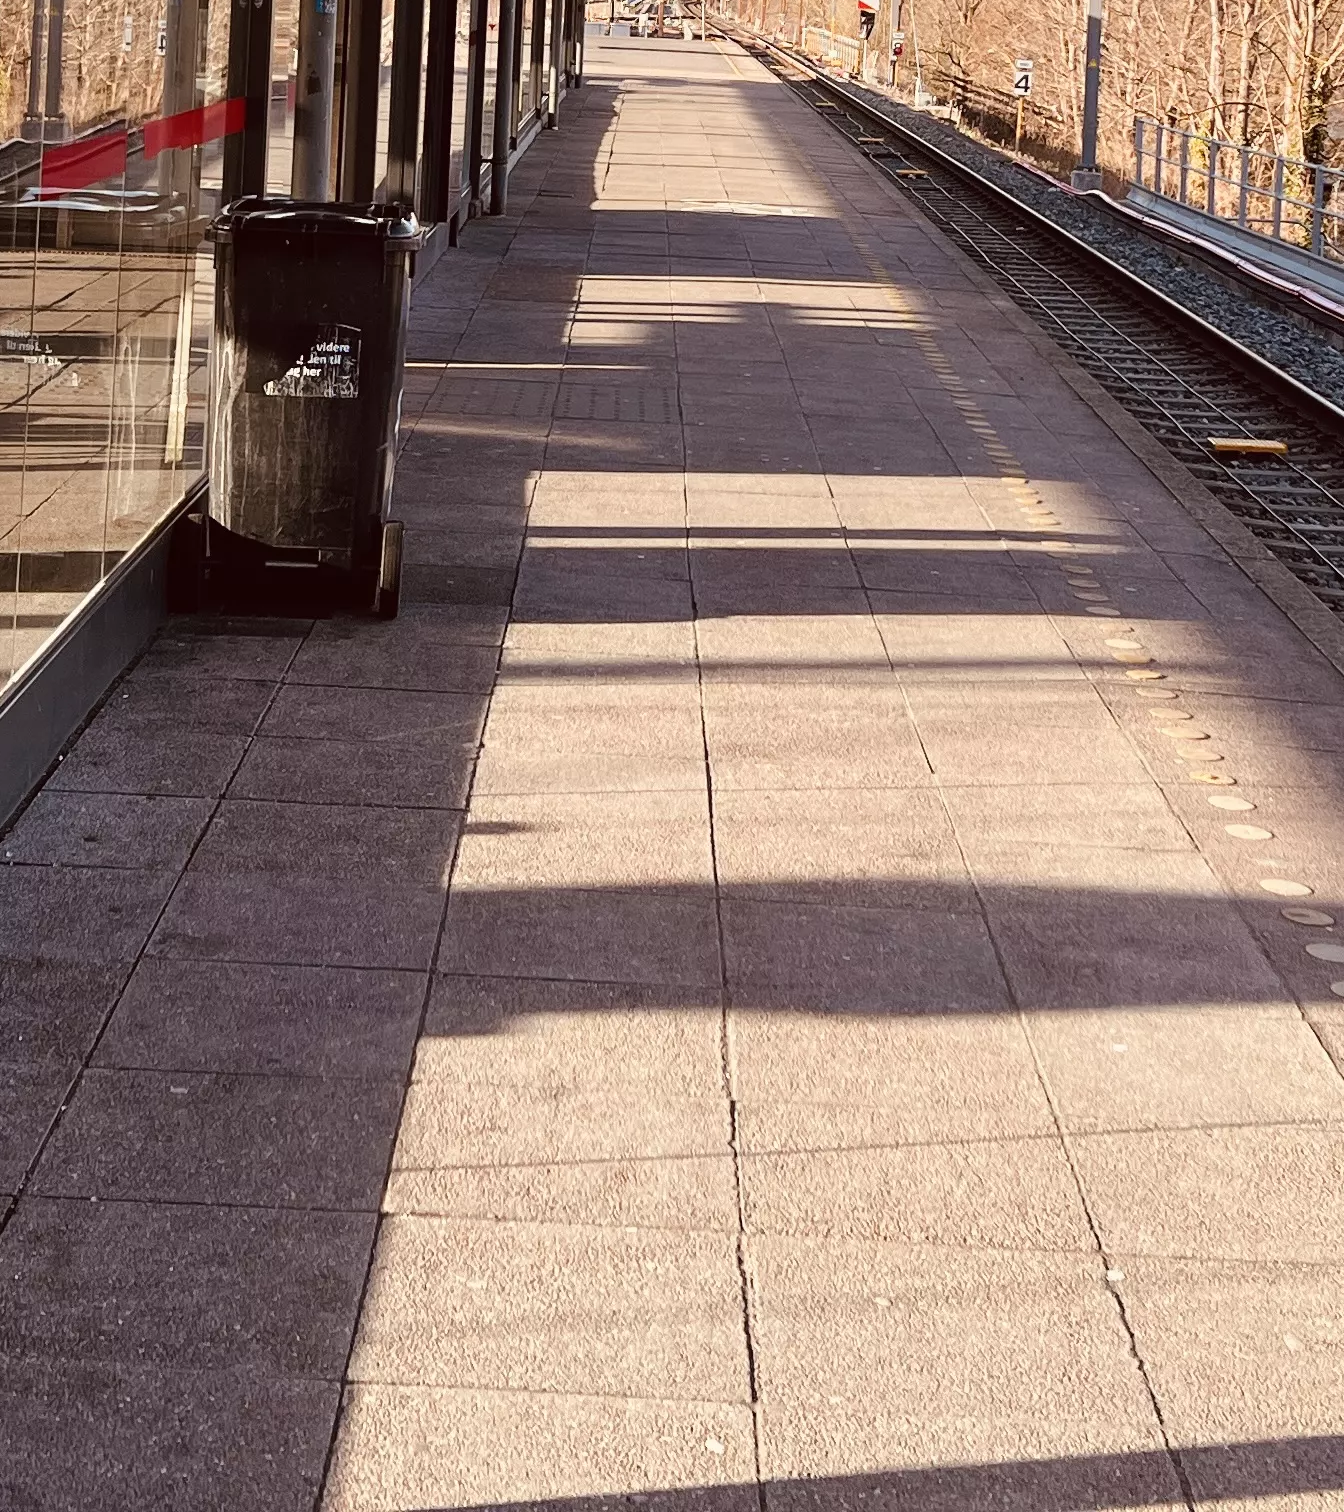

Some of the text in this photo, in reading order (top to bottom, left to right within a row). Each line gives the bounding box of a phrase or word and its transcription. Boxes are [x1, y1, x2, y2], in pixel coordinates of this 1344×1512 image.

[1014, 74, 1031, 93] 4
[316, 341, 350, 353] videre
[329, 355, 342, 365] til
[303, 366, 323, 377] her
